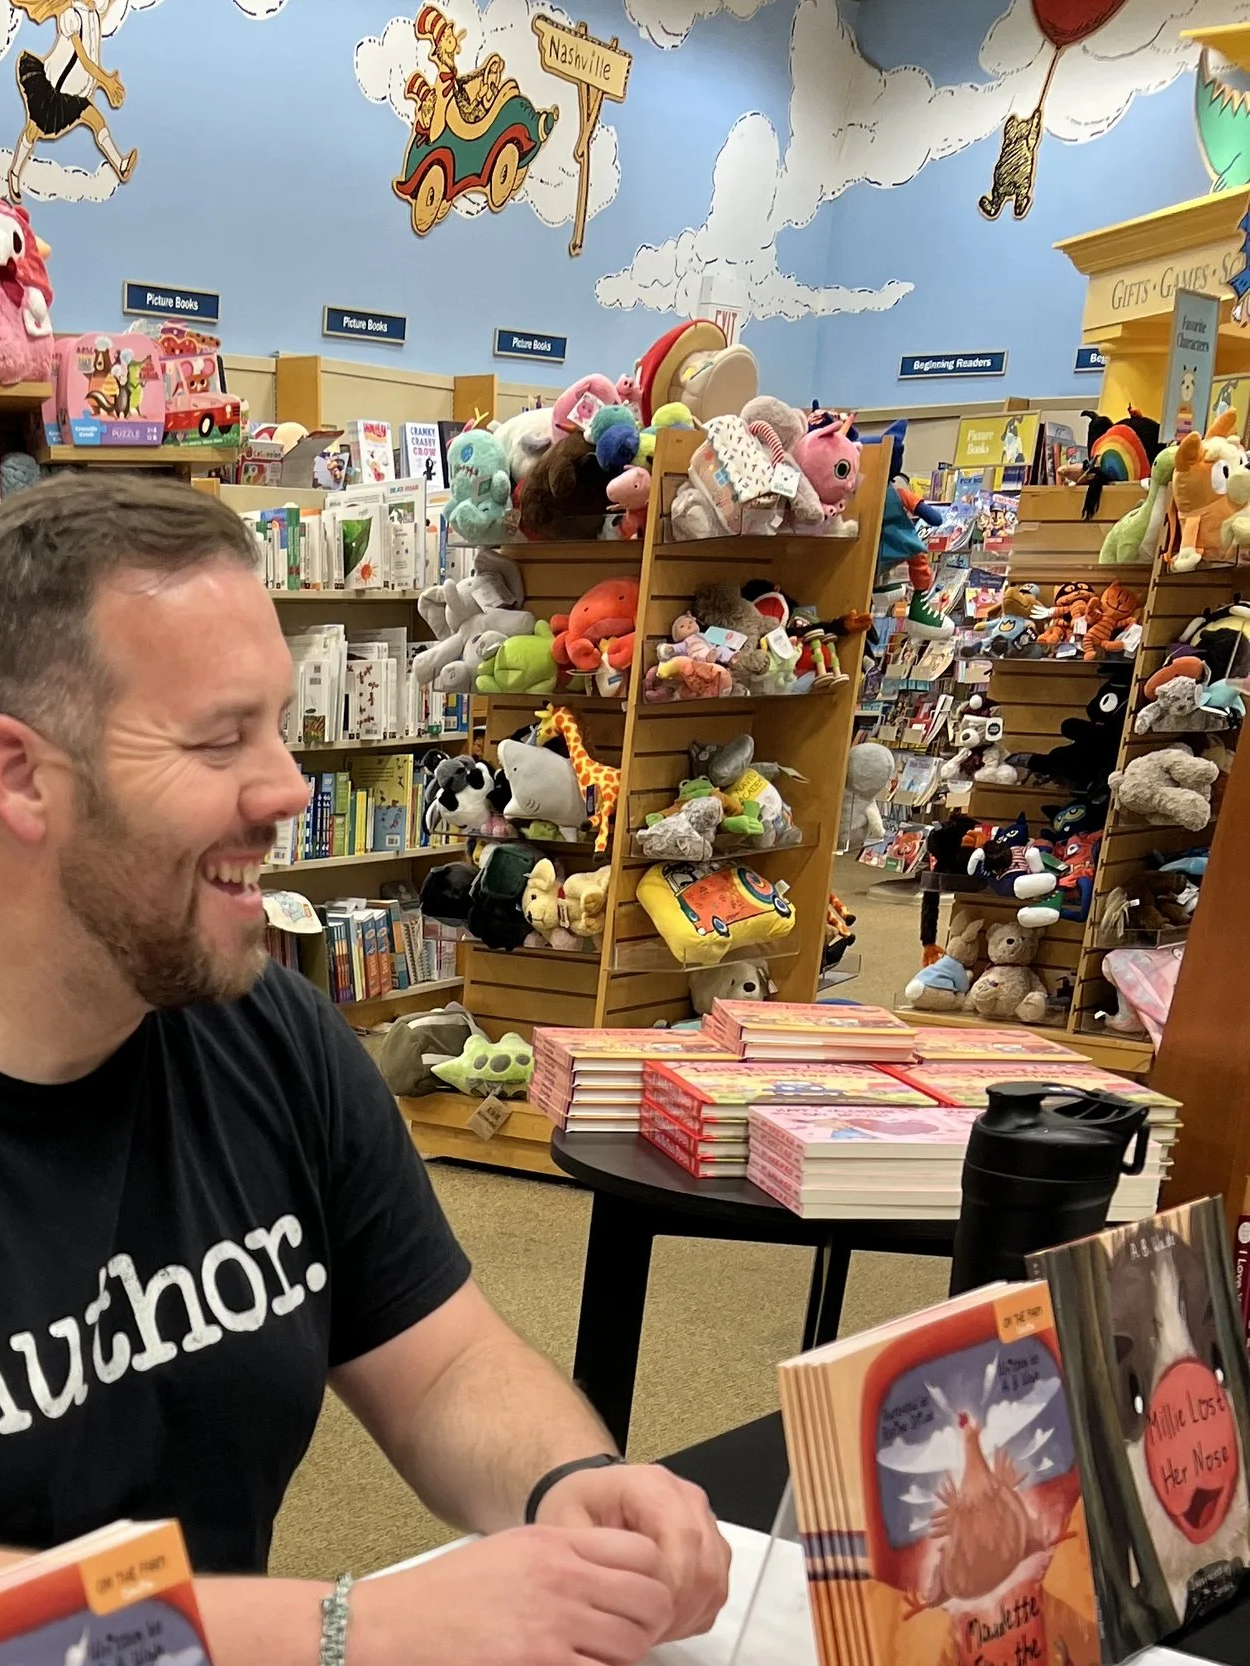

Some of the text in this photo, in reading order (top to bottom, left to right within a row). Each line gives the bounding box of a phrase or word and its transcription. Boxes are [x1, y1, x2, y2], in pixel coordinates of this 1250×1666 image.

[549, 35, 612, 82] Nashville
[1111, 278, 1150, 310] GIFTS
[1160, 263, 1210, 299] GAMES
[146, 292, 199, 311] Picture Books
[343, 316, 388, 332] Picture Books
[512, 336, 551, 351] Picture Books
[913, 357, 991, 371] Beginning Readers
[112, 429, 140, 439] PUZZLE
[966, 428, 995, 442] Picture
[411, 437, 437, 448] CRABBY
[413, 447, 436, 456] CROW
[1146, 1390, 1226, 1448] Millie Lost
[1161, 1443, 1229, 1495] Her Nose
